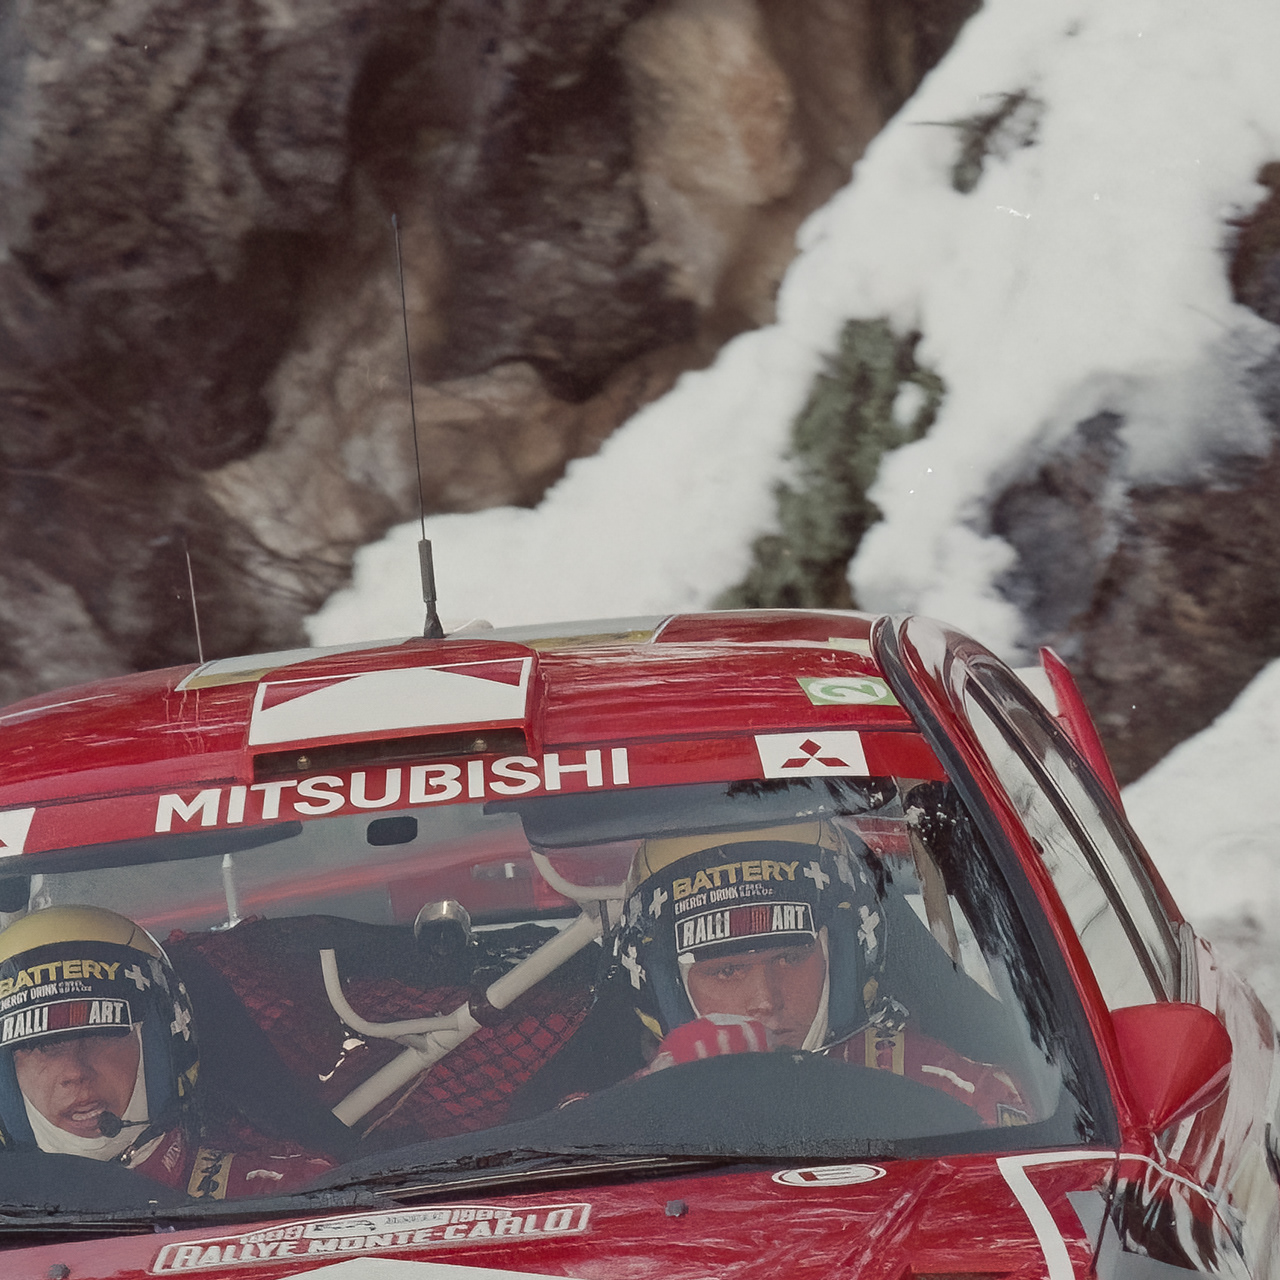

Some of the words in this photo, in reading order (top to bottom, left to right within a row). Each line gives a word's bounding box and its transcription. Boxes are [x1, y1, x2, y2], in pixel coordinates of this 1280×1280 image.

[154, 747, 630, 833] MITSUBISHI
[672, 860, 800, 900] BATTERY
[674, 892, 709, 915] ENERGY
[683, 911, 730, 947] RALLI
[772, 905, 806, 931] ART
[30, 982, 58, 1000] DRINK
[2, 1006, 49, 1042] RALLI
[89, 1001, 124, 1024] ART
[171, 1241, 298, 1269] RALLYE
[308, 1209, 575, 1254] MONTE-CARLO
